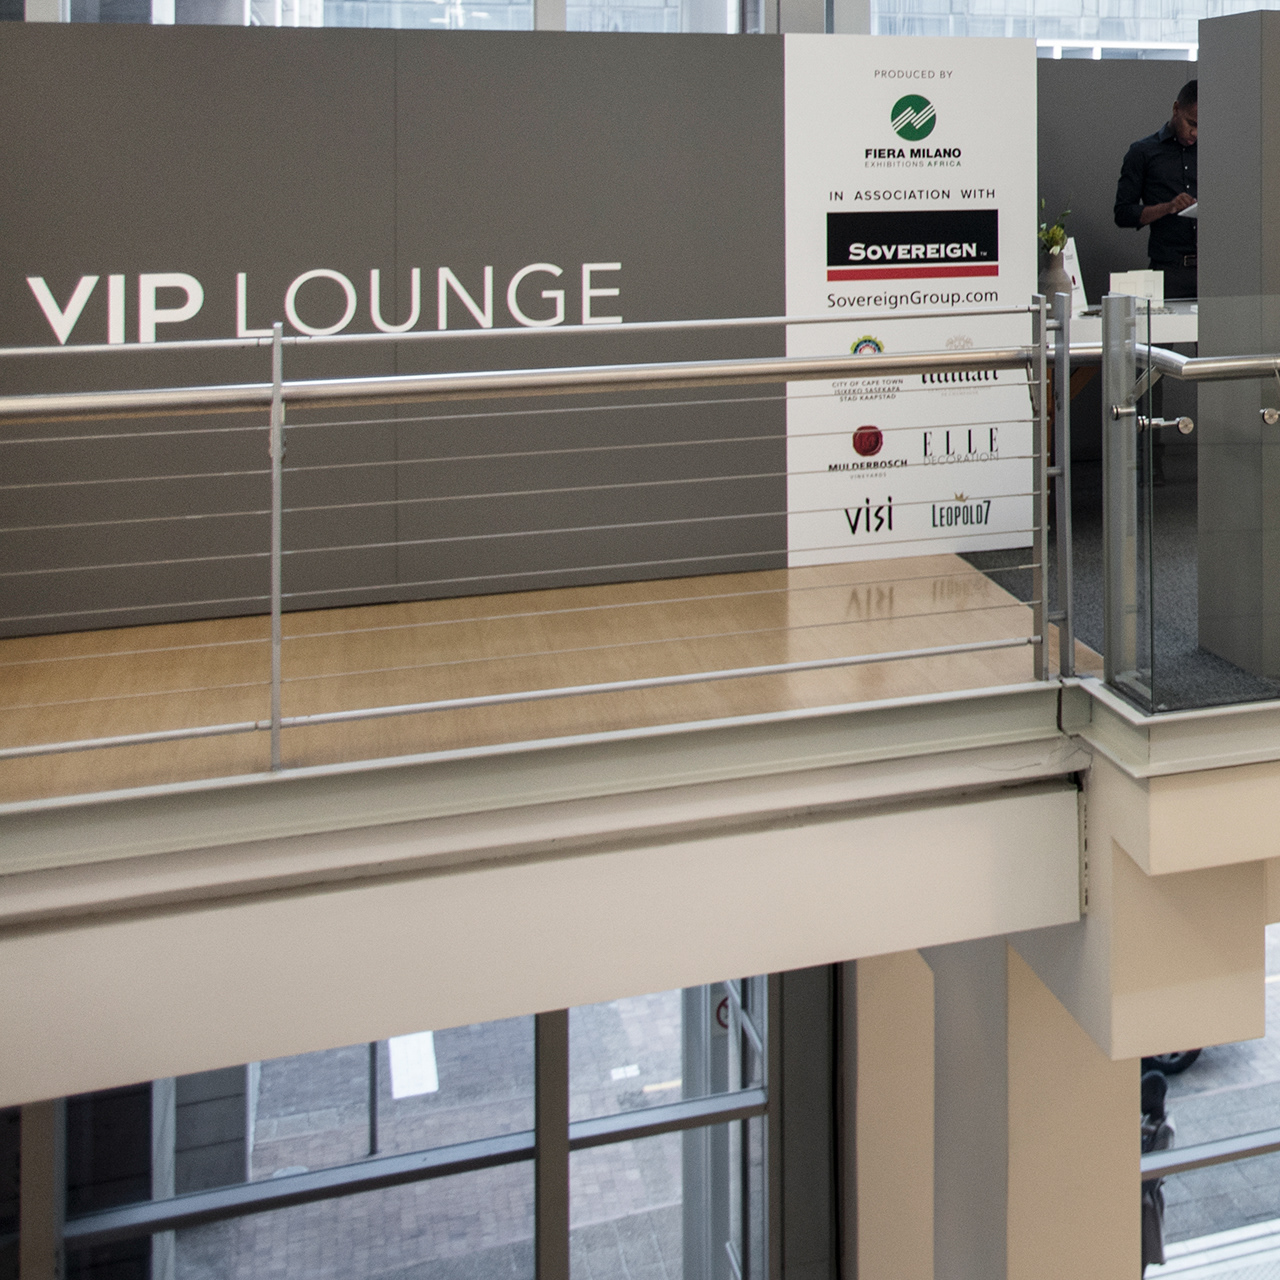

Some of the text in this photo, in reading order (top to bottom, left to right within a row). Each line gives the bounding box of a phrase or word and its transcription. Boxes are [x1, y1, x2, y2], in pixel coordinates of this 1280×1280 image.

[874, 70, 953, 79] PRODUCED BY
[864, 147, 962, 159] FIERA MILANO
[829, 189, 996, 201] IN ASSOCIATION WITH
[848, 242, 977, 261] SOVEREIGN
[27, 261, 624, 345] VIP LOUNGE
[827, 291, 998, 309] SovereignGroup.com
[924, 427, 998, 457] ELLE
[828, 459, 908, 472] MULDERBOSCH
[924, 452, 999, 466] DECORATION
